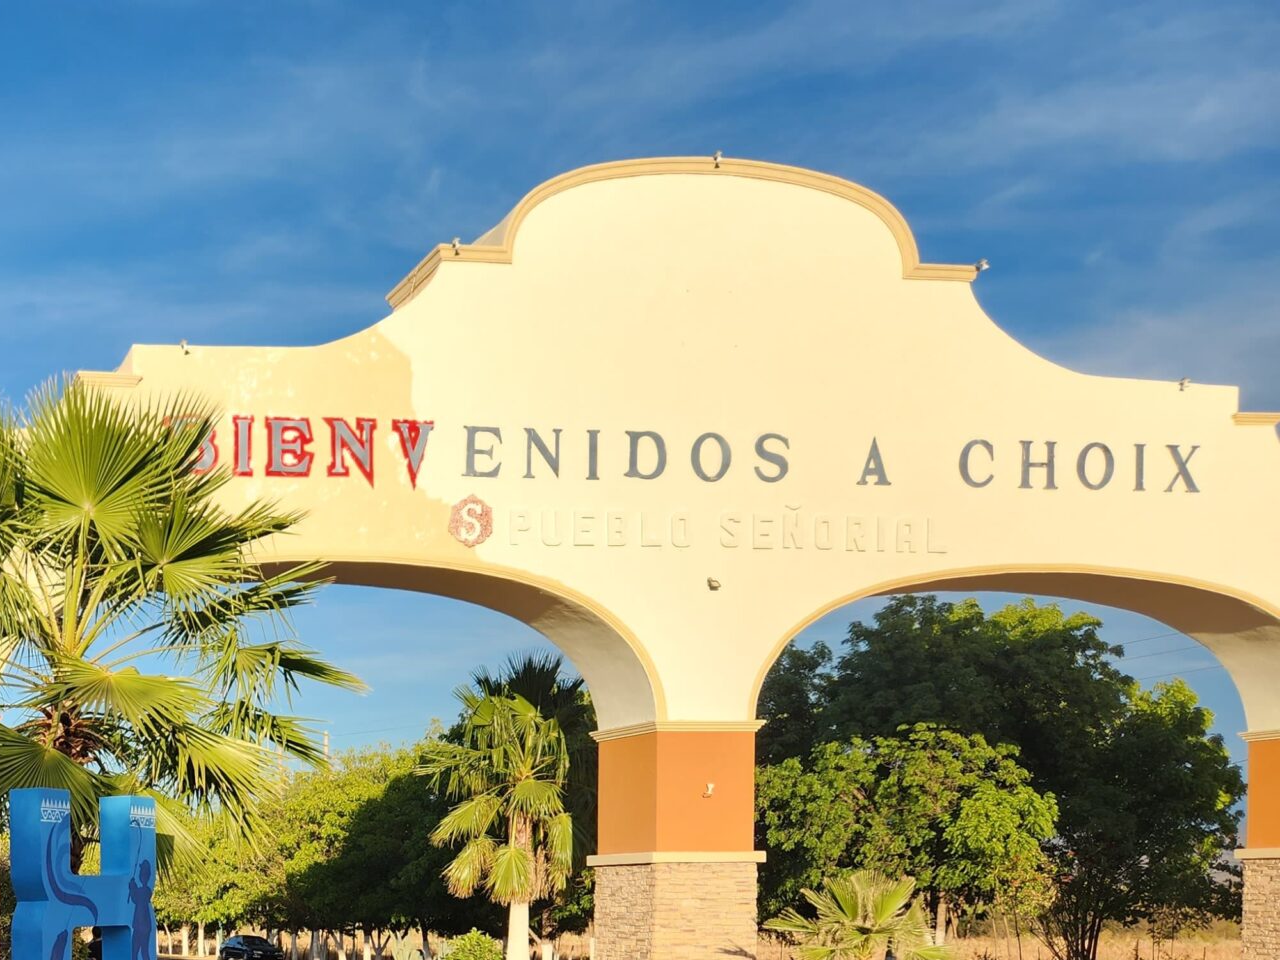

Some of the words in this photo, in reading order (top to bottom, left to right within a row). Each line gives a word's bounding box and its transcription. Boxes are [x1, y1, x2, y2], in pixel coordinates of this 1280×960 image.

[856, 436, 892, 486] A
[958, 438, 1201, 493] CHOIX
[509, 508, 692, 549] PUEBLO
[719, 504, 948, 555] SEÑORIAL
